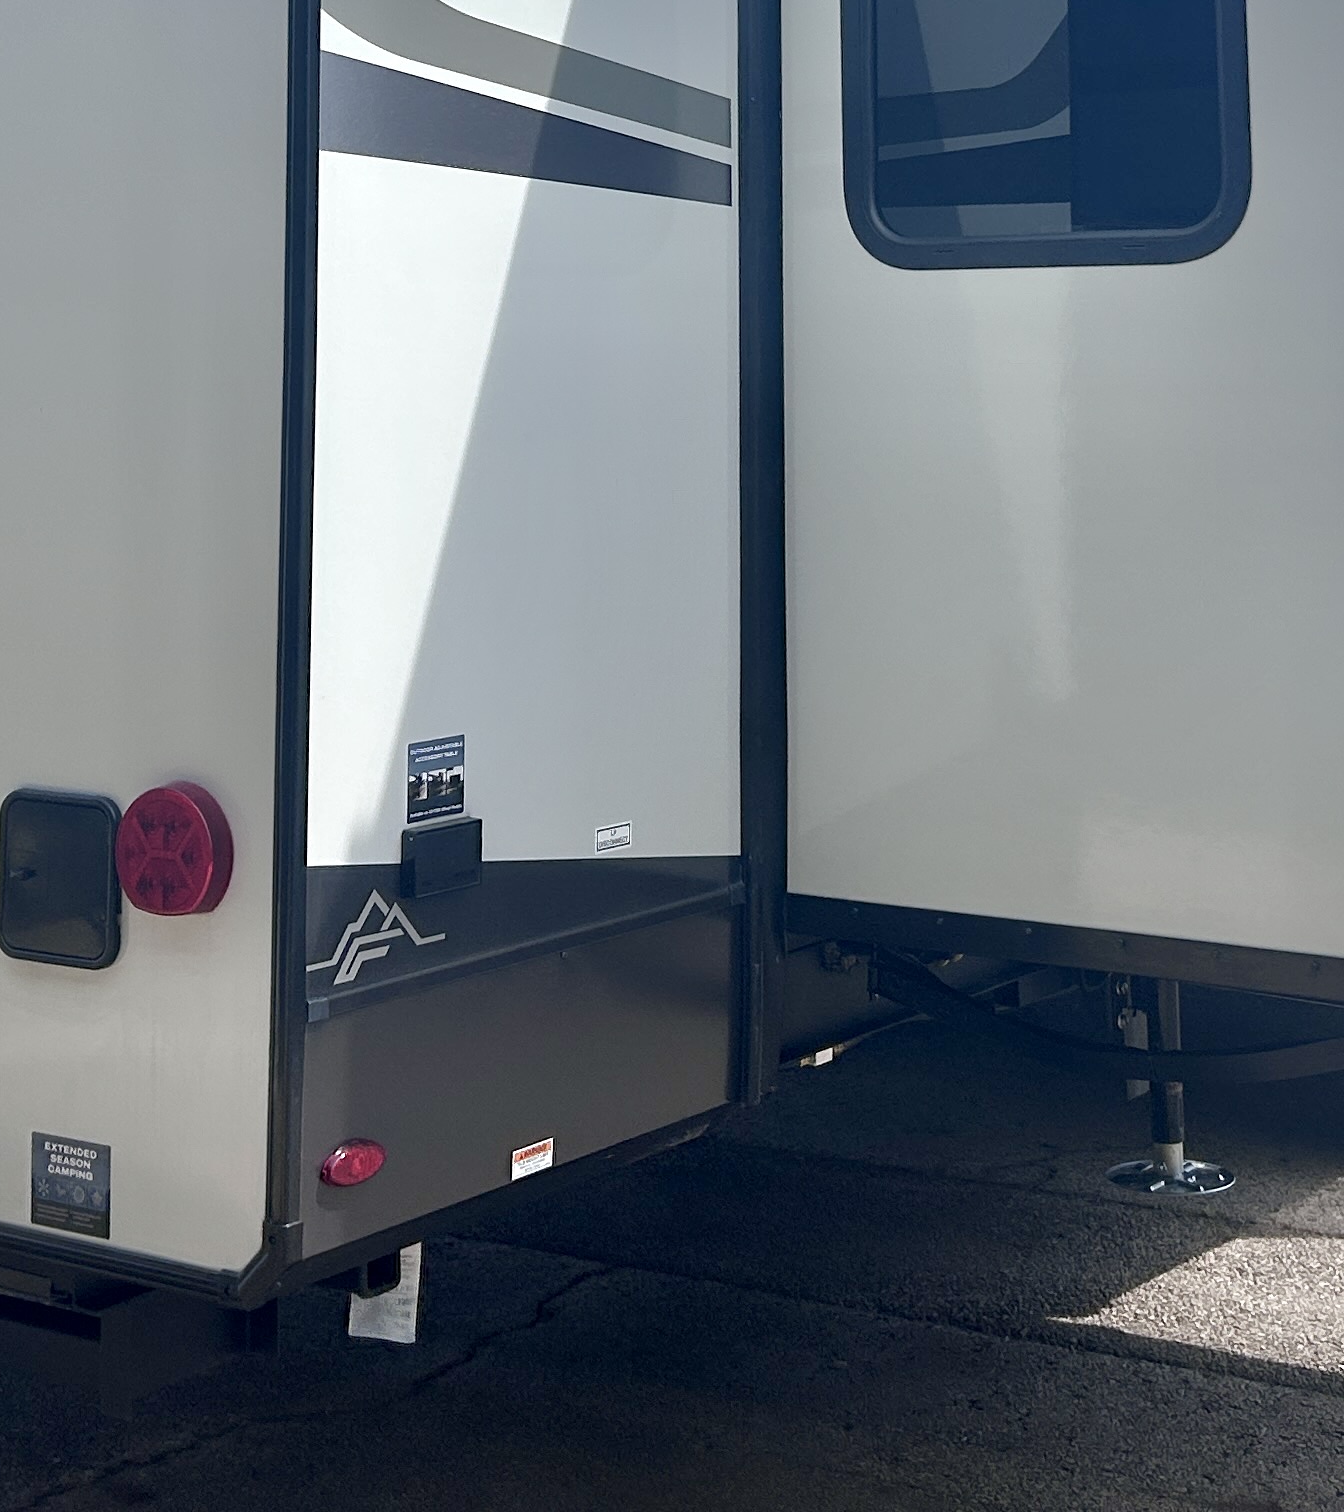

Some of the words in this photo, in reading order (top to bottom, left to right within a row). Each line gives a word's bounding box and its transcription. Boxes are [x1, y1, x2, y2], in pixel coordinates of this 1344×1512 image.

[44, 1141, 98, 1160] EXTENDED
[50, 1153, 91, 1169] SEASON
[47, 1164, 94, 1181] CAMPING
